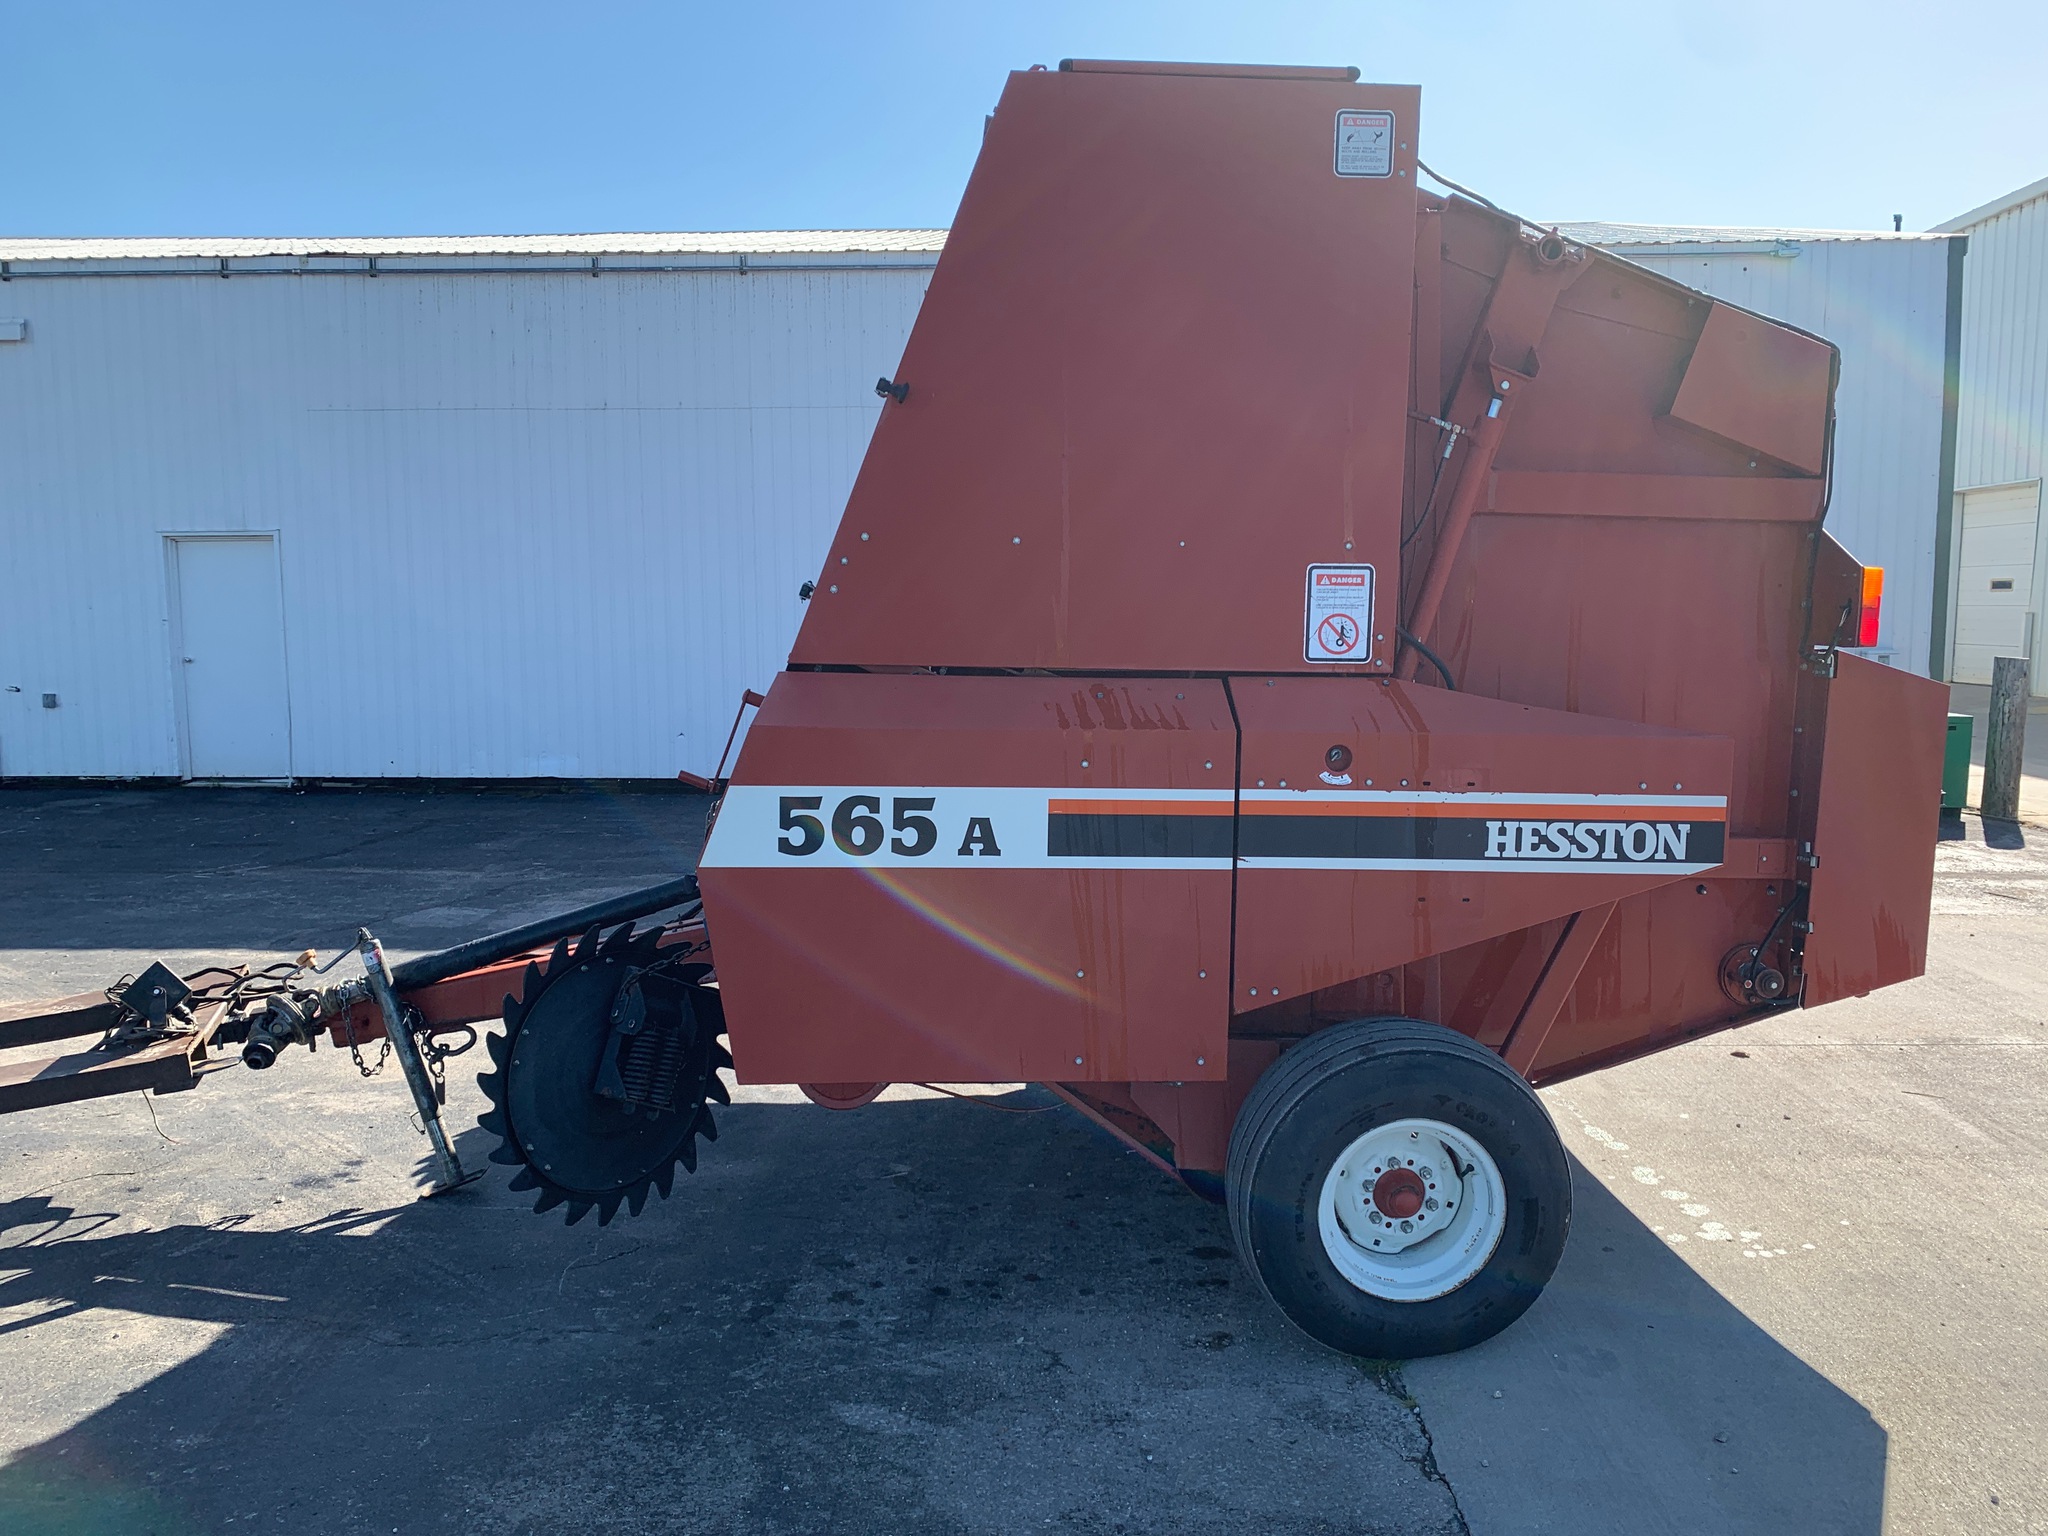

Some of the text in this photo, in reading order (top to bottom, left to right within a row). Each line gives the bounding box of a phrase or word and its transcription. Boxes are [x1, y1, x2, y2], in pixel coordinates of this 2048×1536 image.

[777, 795, 1002, 857] 565 A
[1484, 821, 1691, 861] HESSTON
